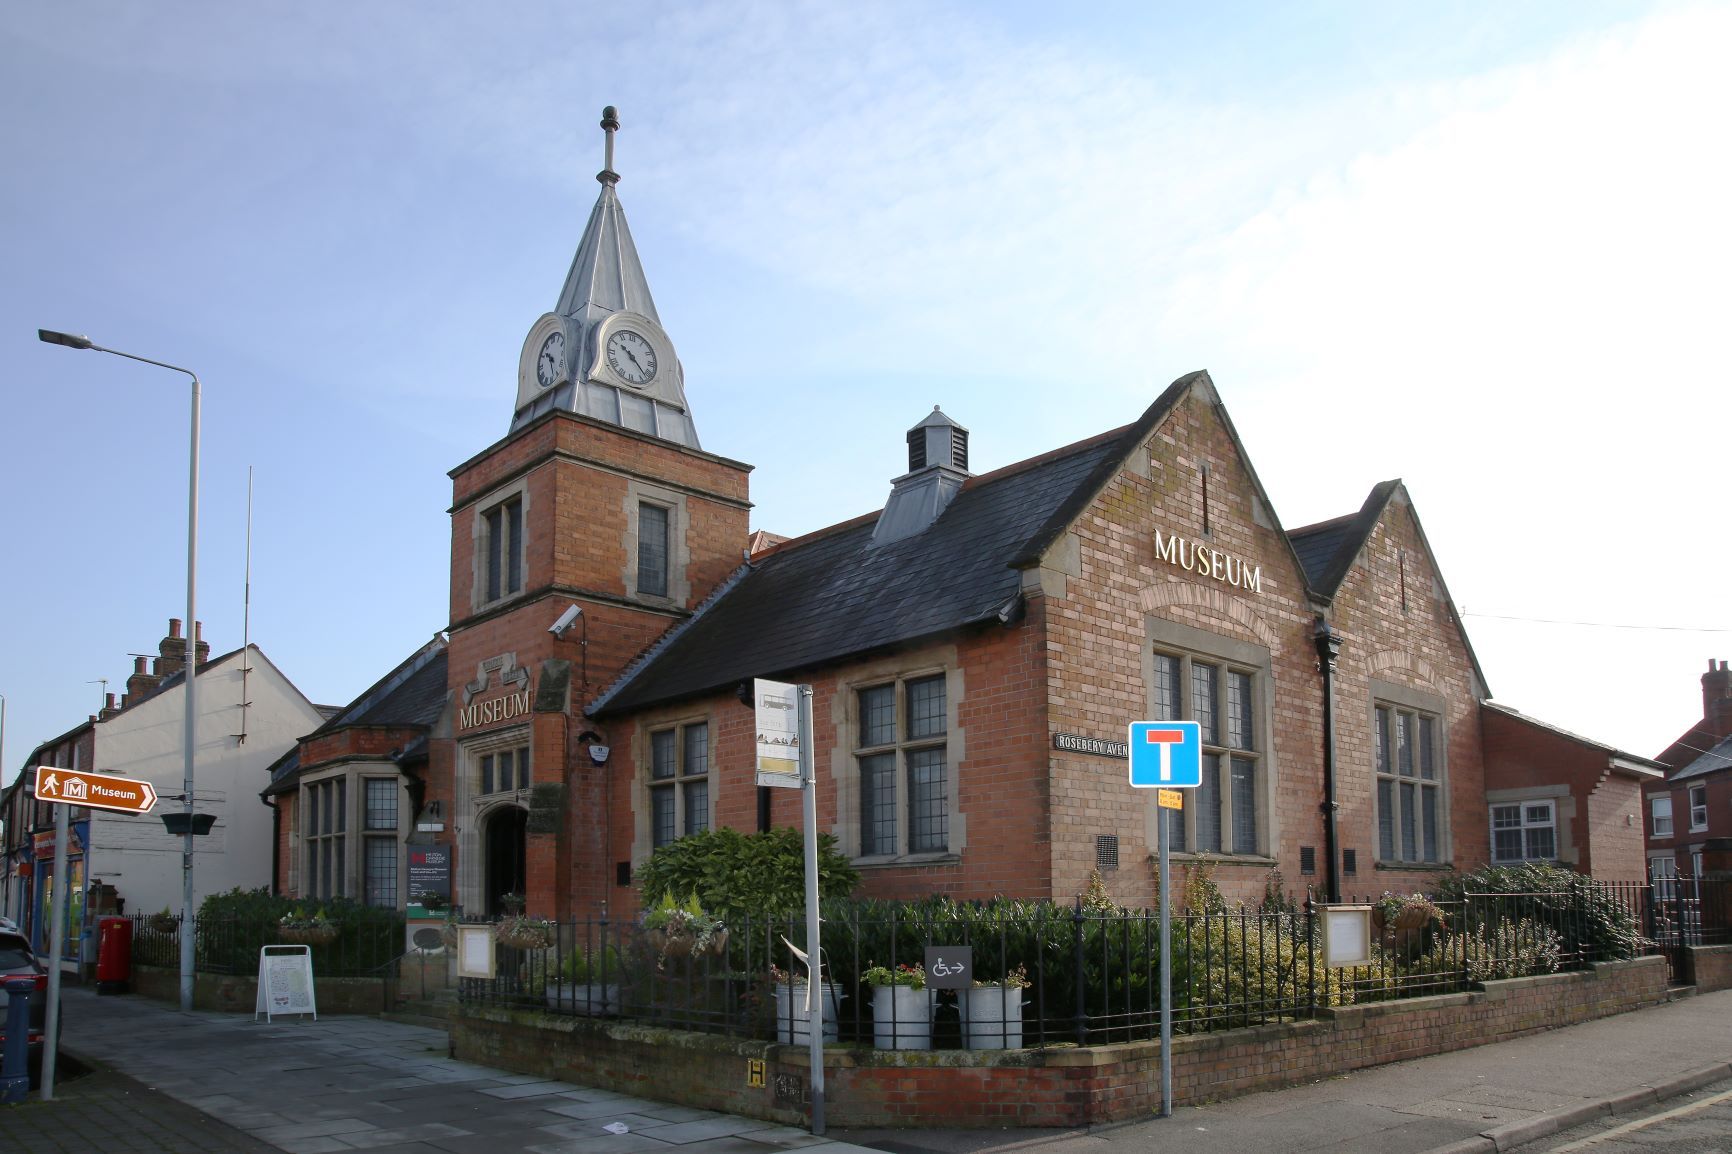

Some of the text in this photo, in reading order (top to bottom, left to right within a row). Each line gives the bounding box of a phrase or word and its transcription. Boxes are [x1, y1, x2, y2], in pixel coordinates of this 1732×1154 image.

[1154, 528, 1262, 593] MUSEUM
[460, 690, 530, 730] MUSEUM
[1059, 735, 1129, 756] ROSEBERY AVEN
[91, 785, 136, 800] Museum
